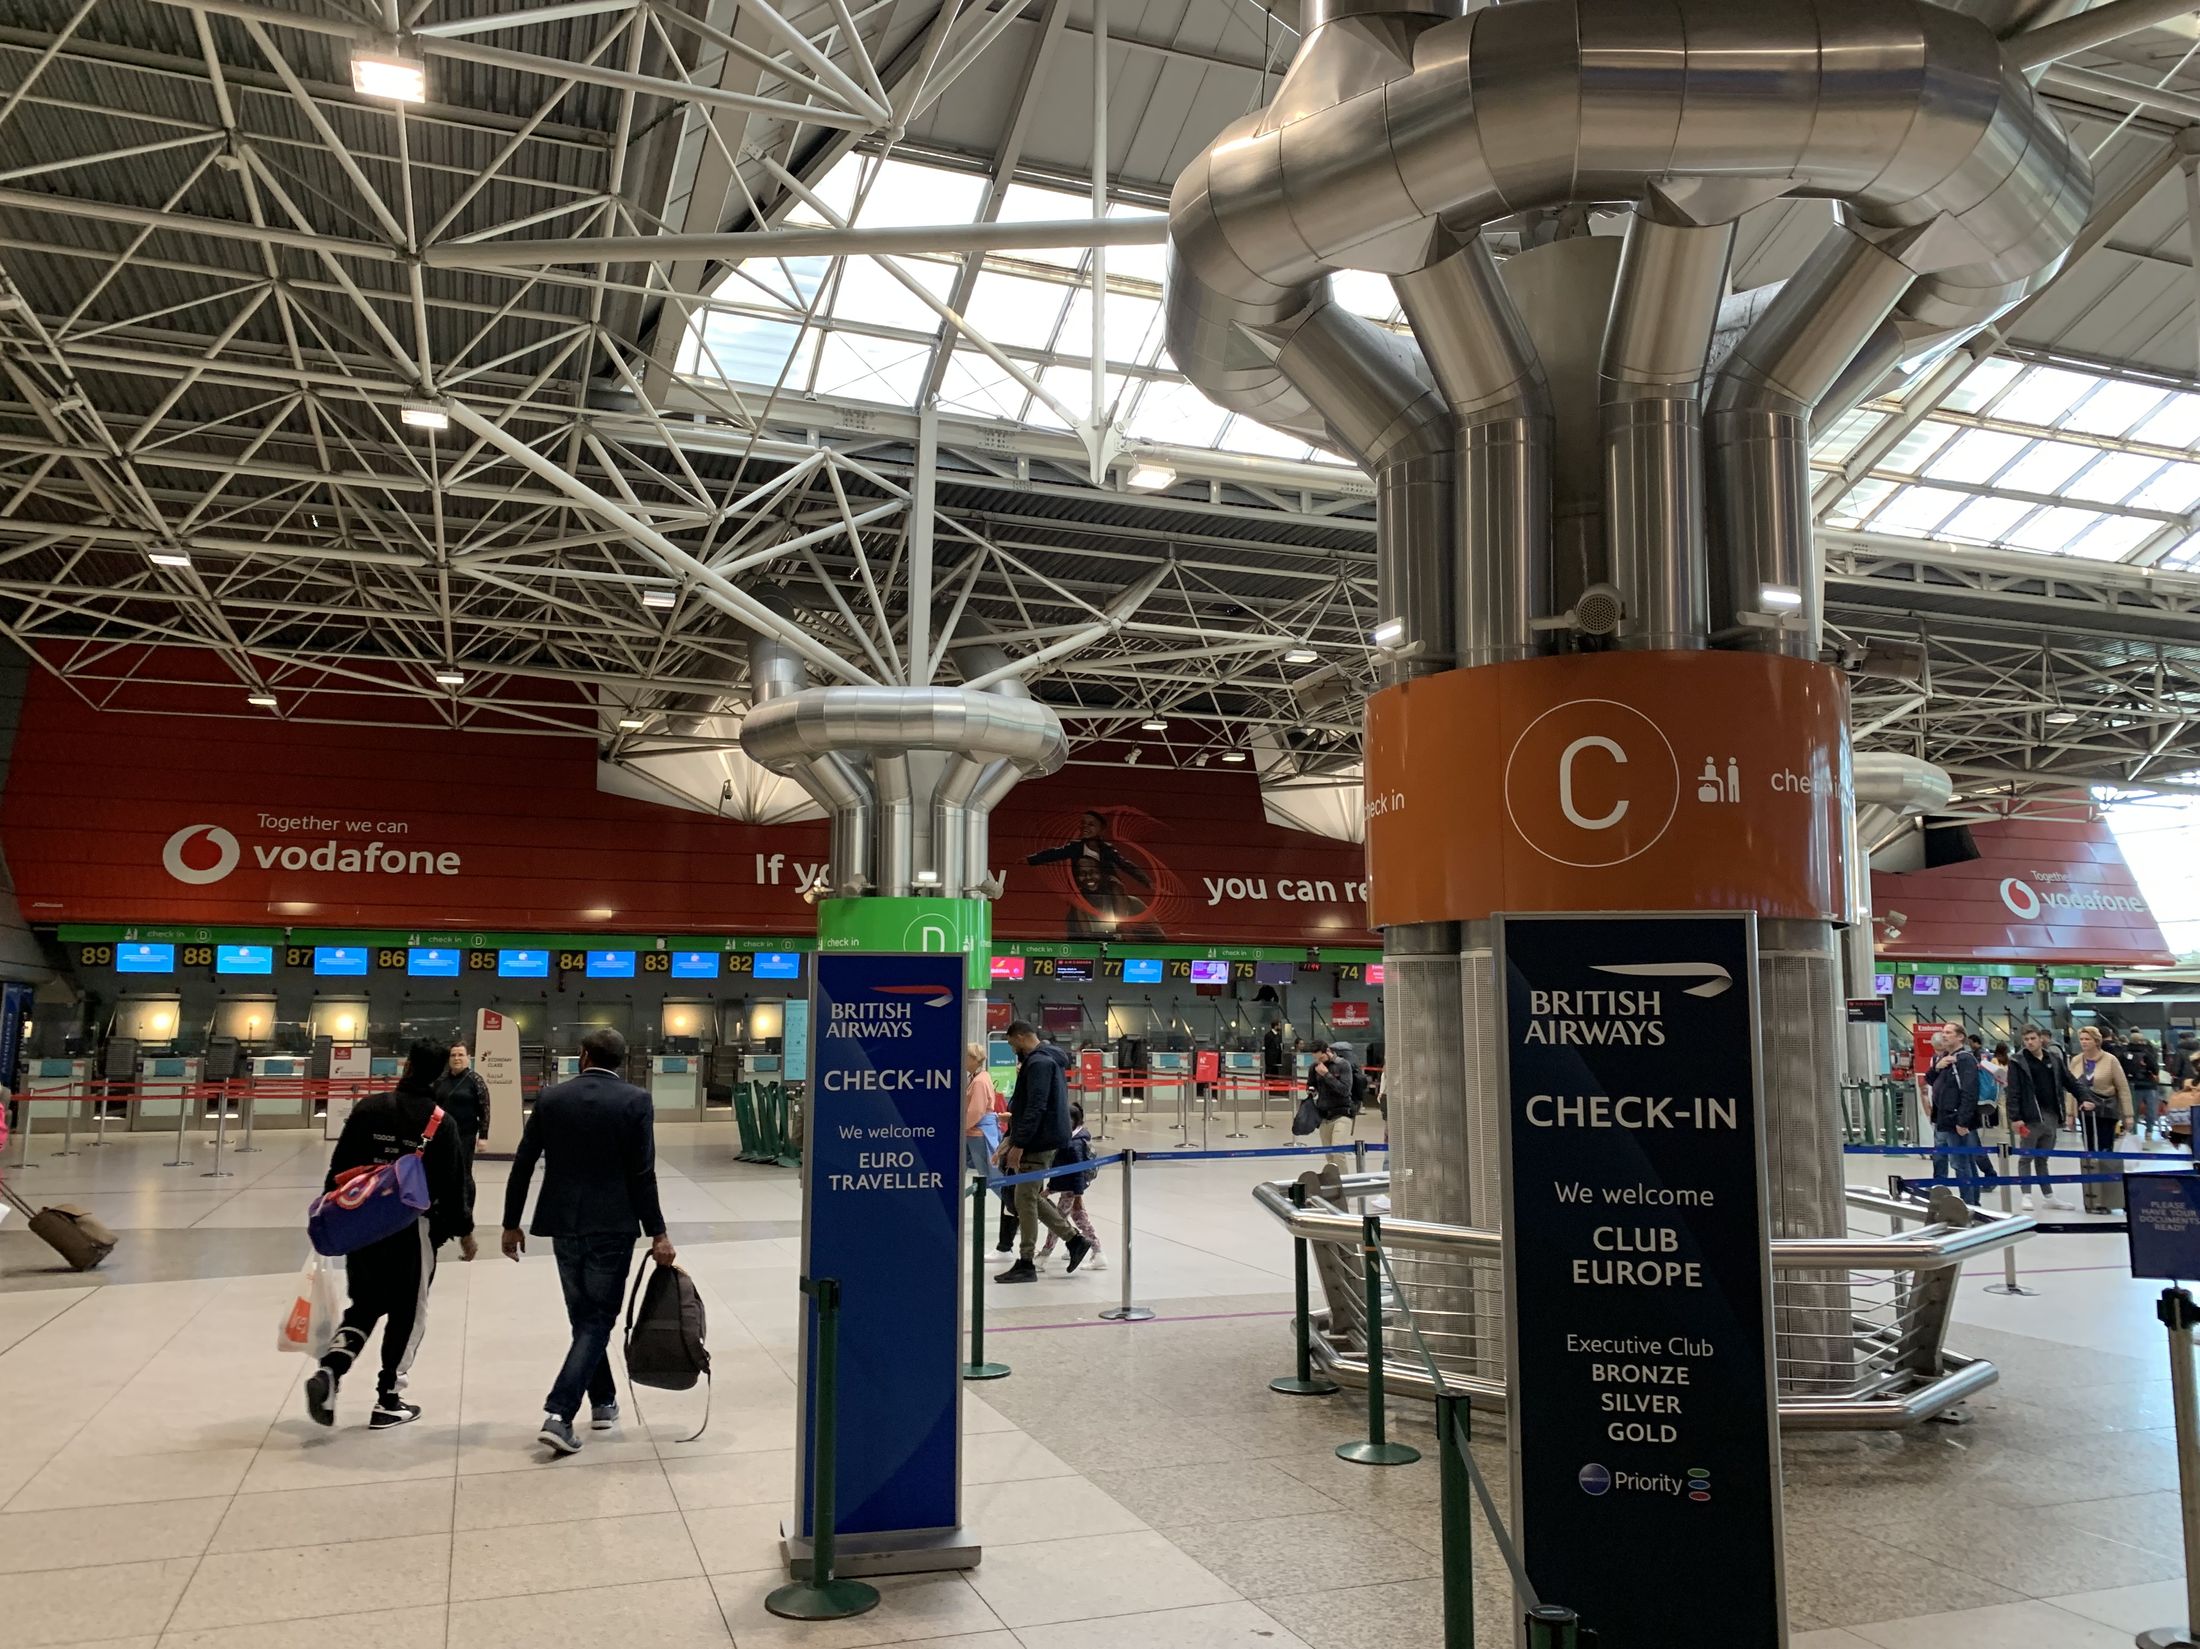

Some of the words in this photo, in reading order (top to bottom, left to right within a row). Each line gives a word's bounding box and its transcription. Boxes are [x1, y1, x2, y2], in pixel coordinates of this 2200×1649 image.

[1559, 735, 1629, 830] C
[1391, 788, 1405, 811] in
[257, 813, 340, 832] Together
[346, 819, 372, 833] we
[375, 820, 408, 834] can
[253, 840, 461, 875] vodafone
[755, 853, 785, 885] If
[1203, 877, 1268, 906] you
[1277, 879, 1337, 902] can
[2041, 890, 2145, 913] vodafone
[827, 937, 849, 947] check
[851, 937, 860, 946] in
[922, 926, 945, 952] D
[81, 947, 111, 964] 89
[183, 948, 212, 965] 88
[286, 948, 313, 965] 87
[379, 950, 406, 967] 86
[470, 952, 496, 969] 85
[560, 954, 585, 970] 84
[645, 955, 669, 971] 83
[729, 955, 752, 971] 82
[1033, 960, 1053, 974] 78
[1104, 961, 1122, 976] 77
[1171, 962, 1190, 977] 76
[1235, 963, 1254, 978] 75
[1340, 965, 1359, 979] 74
[1896, 976, 1911, 989] 64
[1944, 978, 1959, 990] 63
[1990, 978, 2004, 990] 62
[831, 1003, 911, 1019] BRITISH
[1530, 990, 1661, 1016] BRITISH
[826, 1021, 913, 1038] AIRWAYS
[1524, 1020, 1666, 1045] AIRWAYS
[824, 1069, 951, 1091] CHECK-IN
[1526, 1094, 1737, 1129] CHECK-IN
[839, 1125, 863, 1139] We
[867, 1123, 936, 1138] welcome
[859, 1151, 914, 1168] EURO
[828, 1172, 943, 1191] TRAVELLER
[1554, 1181, 1593, 1203] We
[1602, 1183, 1714, 1207] welcome
[1593, 1226, 1678, 1252] CLUB
[1572, 1259, 1703, 1287] EUROPE
[1567, 1333, 1662, 1355] Executive
[1668, 1337, 1714, 1357] Club
[1592, 1363, 1690, 1385] BRONZE
[1601, 1392, 1682, 1414] SILVER
[1608, 1422, 1678, 1443] GOLD
[1615, 1471, 1683, 1496] Priority
